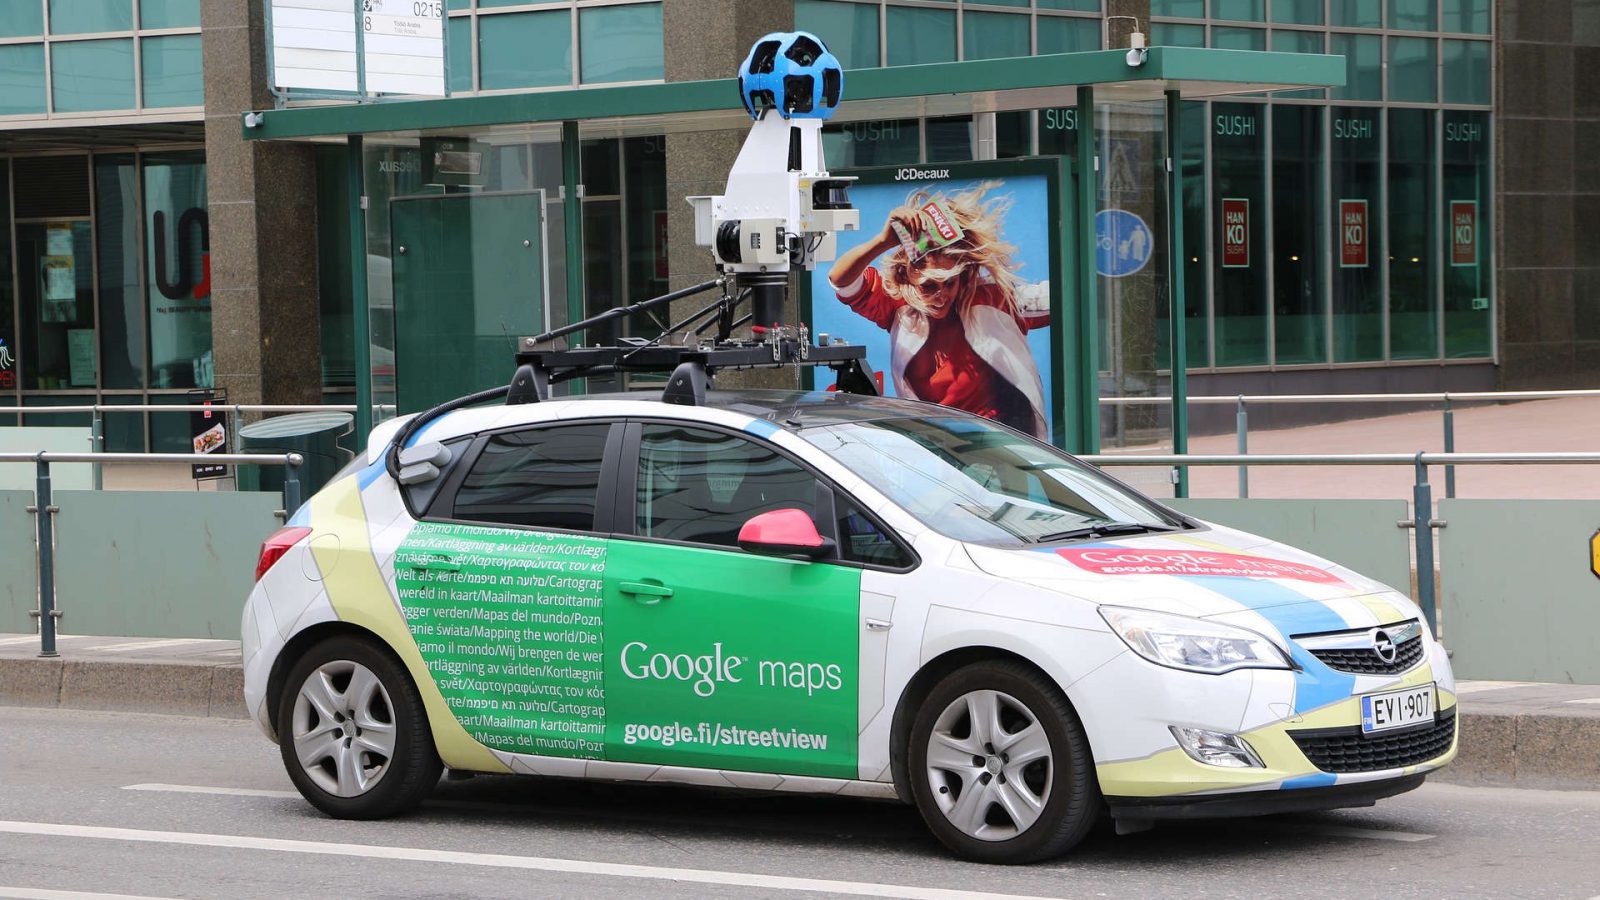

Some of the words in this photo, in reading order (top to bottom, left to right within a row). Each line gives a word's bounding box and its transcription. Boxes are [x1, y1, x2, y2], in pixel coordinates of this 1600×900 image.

[413, 1, 443, 17] 0215
[364, 16, 372, 31] 8
[842, 121, 900, 142] SUSHI
[1216, 115, 1256, 136] SUSHI
[1334, 119, 1372, 139] SUSHI
[1446, 123, 1481, 141] SUSHI
[895, 168, 950, 181] JCDecaux
[923, 204, 954, 240] JENKKI
[1227, 212, 1244, 223] HAN
[1345, 213, 1362, 224] HAN
[1455, 214, 1472, 225] HAN
[1227, 225, 1244, 245] KO
[1345, 225, 1362, 245] KO
[1455, 225, 1472, 245] KO
[497, 543, 511, 552] av
[1081, 551, 1224, 568] Google
[419, 569, 435, 582] als
[400, 587, 435, 599] wereld
[438, 587, 448, 600] in
[451, 588, 533, 604] kaart/Maailman
[432, 606, 508, 625] verden/Mapas
[511, 609, 528, 622] del
[409, 622, 433, 635] anie
[436, 622, 520, 643] świata/Mapping
[523, 628, 541, 641] the
[543, 630, 597, 644] world/Die
[448, 641, 455, 654] il
[457, 643, 515, 661] mondo/Wij
[518, 645, 563, 663] brengen
[566, 648, 580, 661] de
[583, 652, 604, 663] wer
[487, 664, 499, 674] av
[621, 641, 742, 697] Google
[759, 660, 842, 696] maps
[1374, 691, 1429, 725] EVI-907
[516, 734, 533, 746] del
[624, 721, 827, 750] google.fi/streetview
